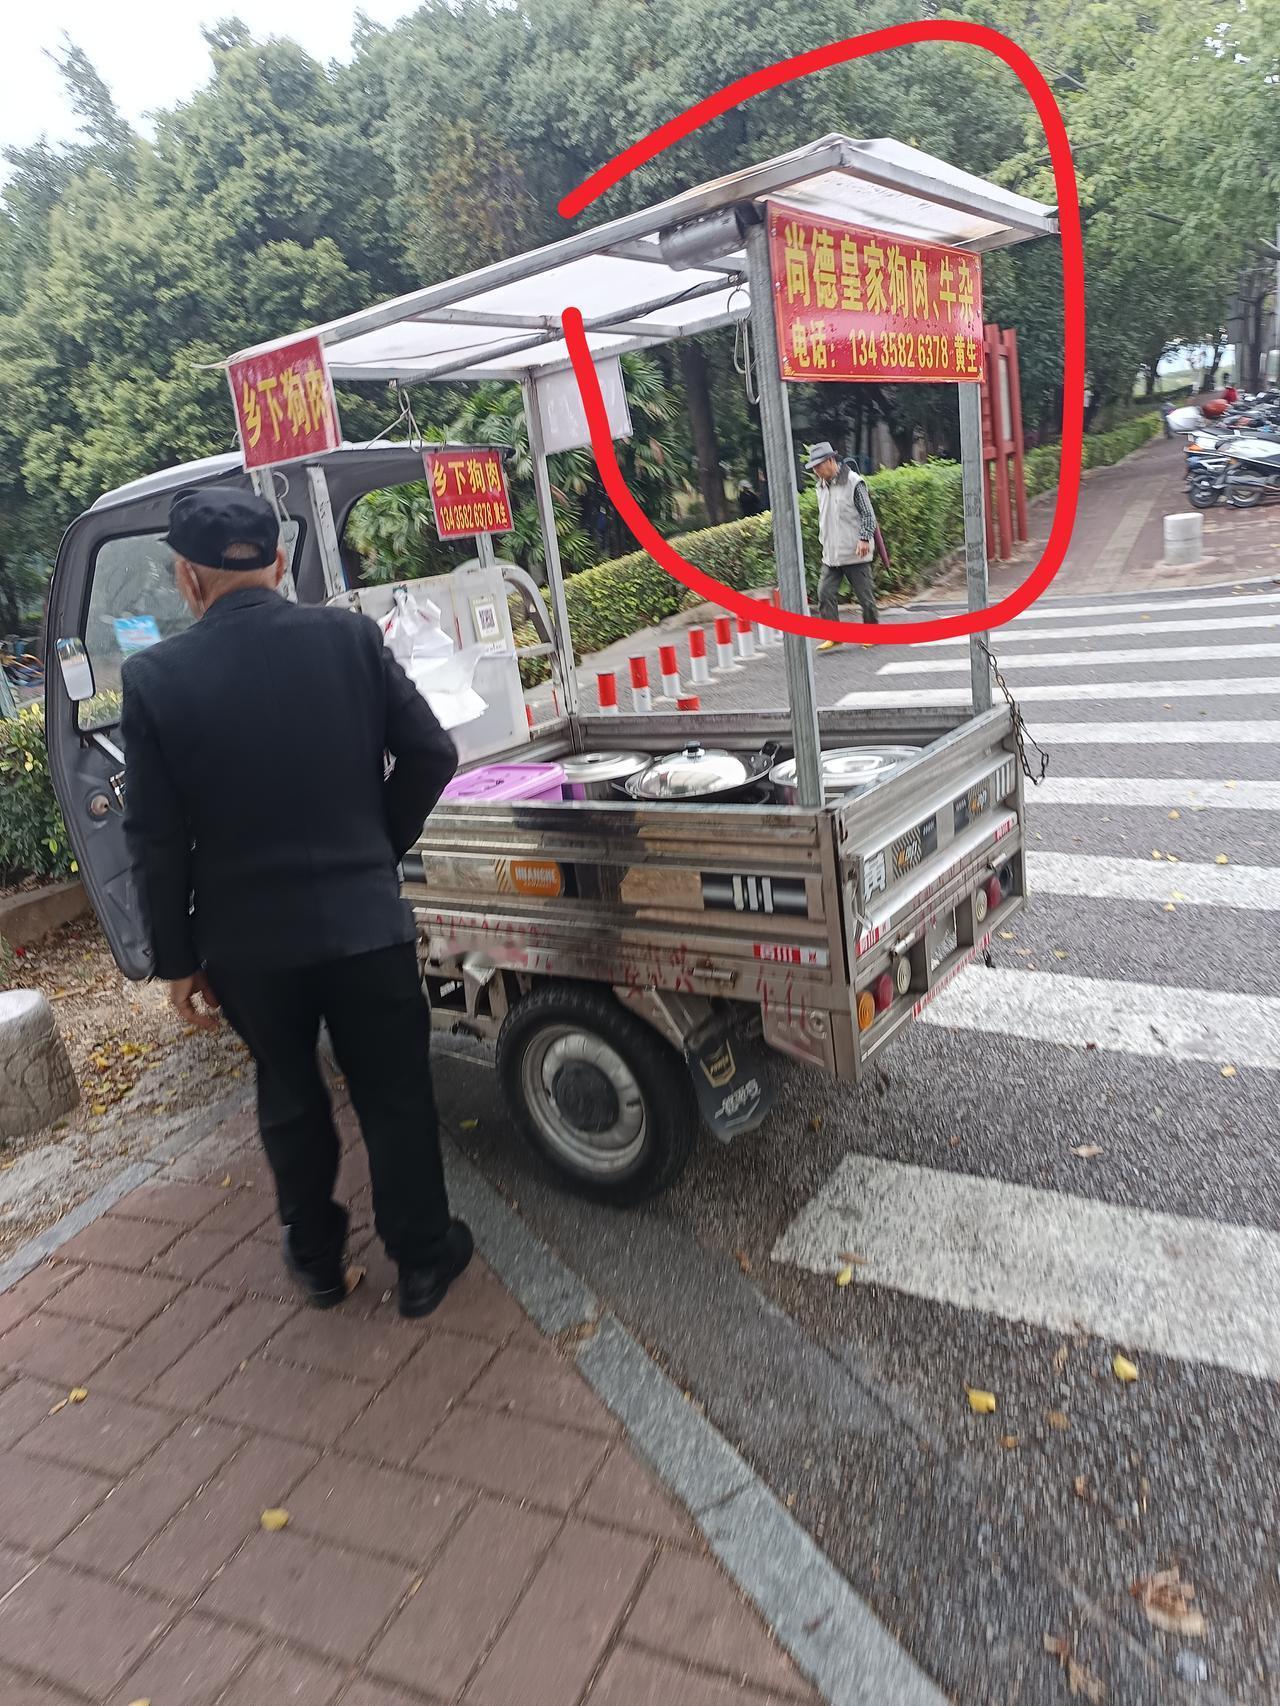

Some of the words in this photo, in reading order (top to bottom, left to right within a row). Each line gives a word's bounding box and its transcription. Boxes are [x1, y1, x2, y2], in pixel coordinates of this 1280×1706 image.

[784, 221, 974, 323] 尚德皇家狗肉、牛杂
[243, 361, 328, 448] 乡下狗肉
[433, 458, 502, 497] 乡下狗肉
